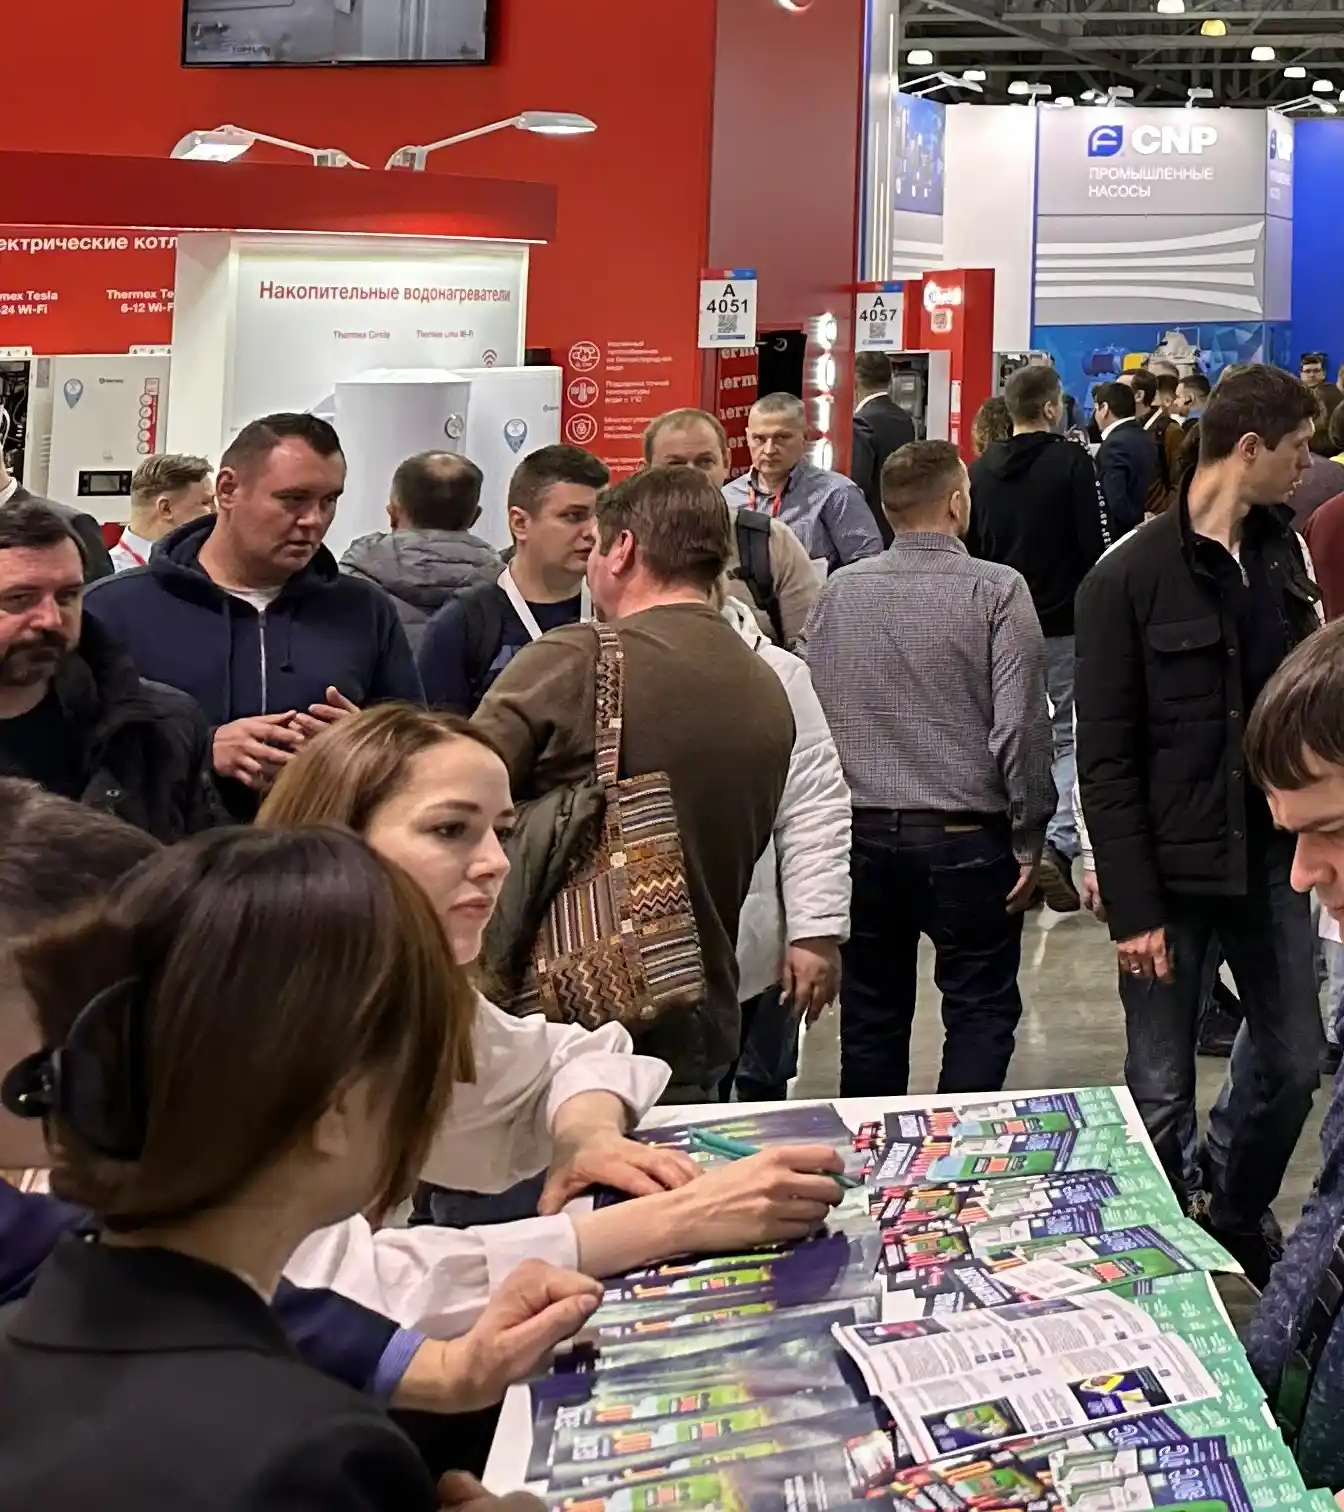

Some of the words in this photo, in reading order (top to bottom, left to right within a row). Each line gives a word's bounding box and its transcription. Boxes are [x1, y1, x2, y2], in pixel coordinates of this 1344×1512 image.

[1130, 124, 1219, 157] CNP
[1088, 166, 1214, 181] ПРОМЫШЛЕННЫЕ
[1088, 184, 1151, 198] НАСОСЫ
[26, 290, 59, 301] Tesla
[106, 289, 157, 301] Thermex
[258, 280, 400, 301] Накопительные
[403, 286, 512, 305] водонагреватели
[722, 283, 736, 298] A
[18, 303, 48, 315] Wi-Fi
[120, 303, 146, 314] 6-12
[706, 298, 749, 314] 4051
[872, 295, 885, 309] A
[859, 308, 898, 322] 4057
